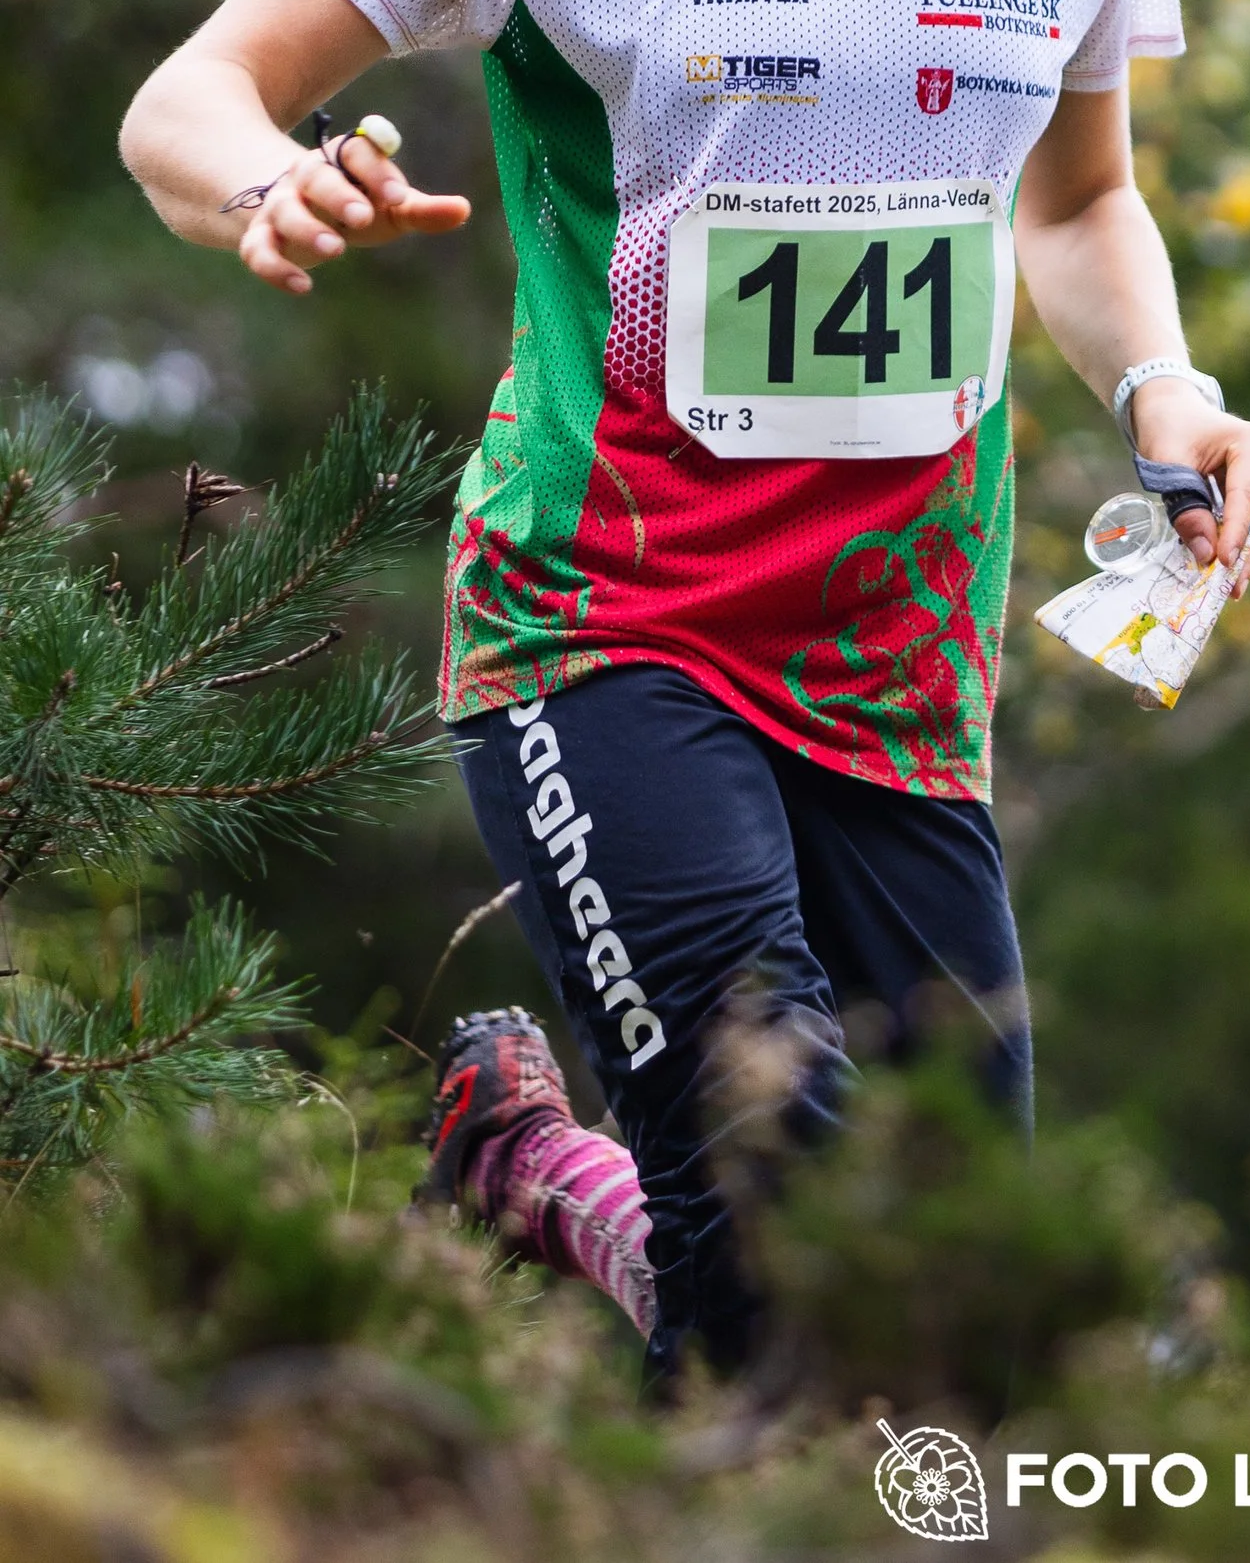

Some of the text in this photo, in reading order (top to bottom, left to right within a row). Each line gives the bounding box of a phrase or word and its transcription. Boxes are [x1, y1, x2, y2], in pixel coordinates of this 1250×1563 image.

[985, 14, 1048, 38] BOTKYRKA
[723, 55, 822, 80] TIGER
[724, 77, 798, 92] SPORTS
[956, 75, 1023, 95] BOTKYRKA
[705, 188, 991, 215] DM-stafett 2025, Länna-Veda
[737, 236, 952, 384] 141
[687, 406, 754, 432] Str 3
